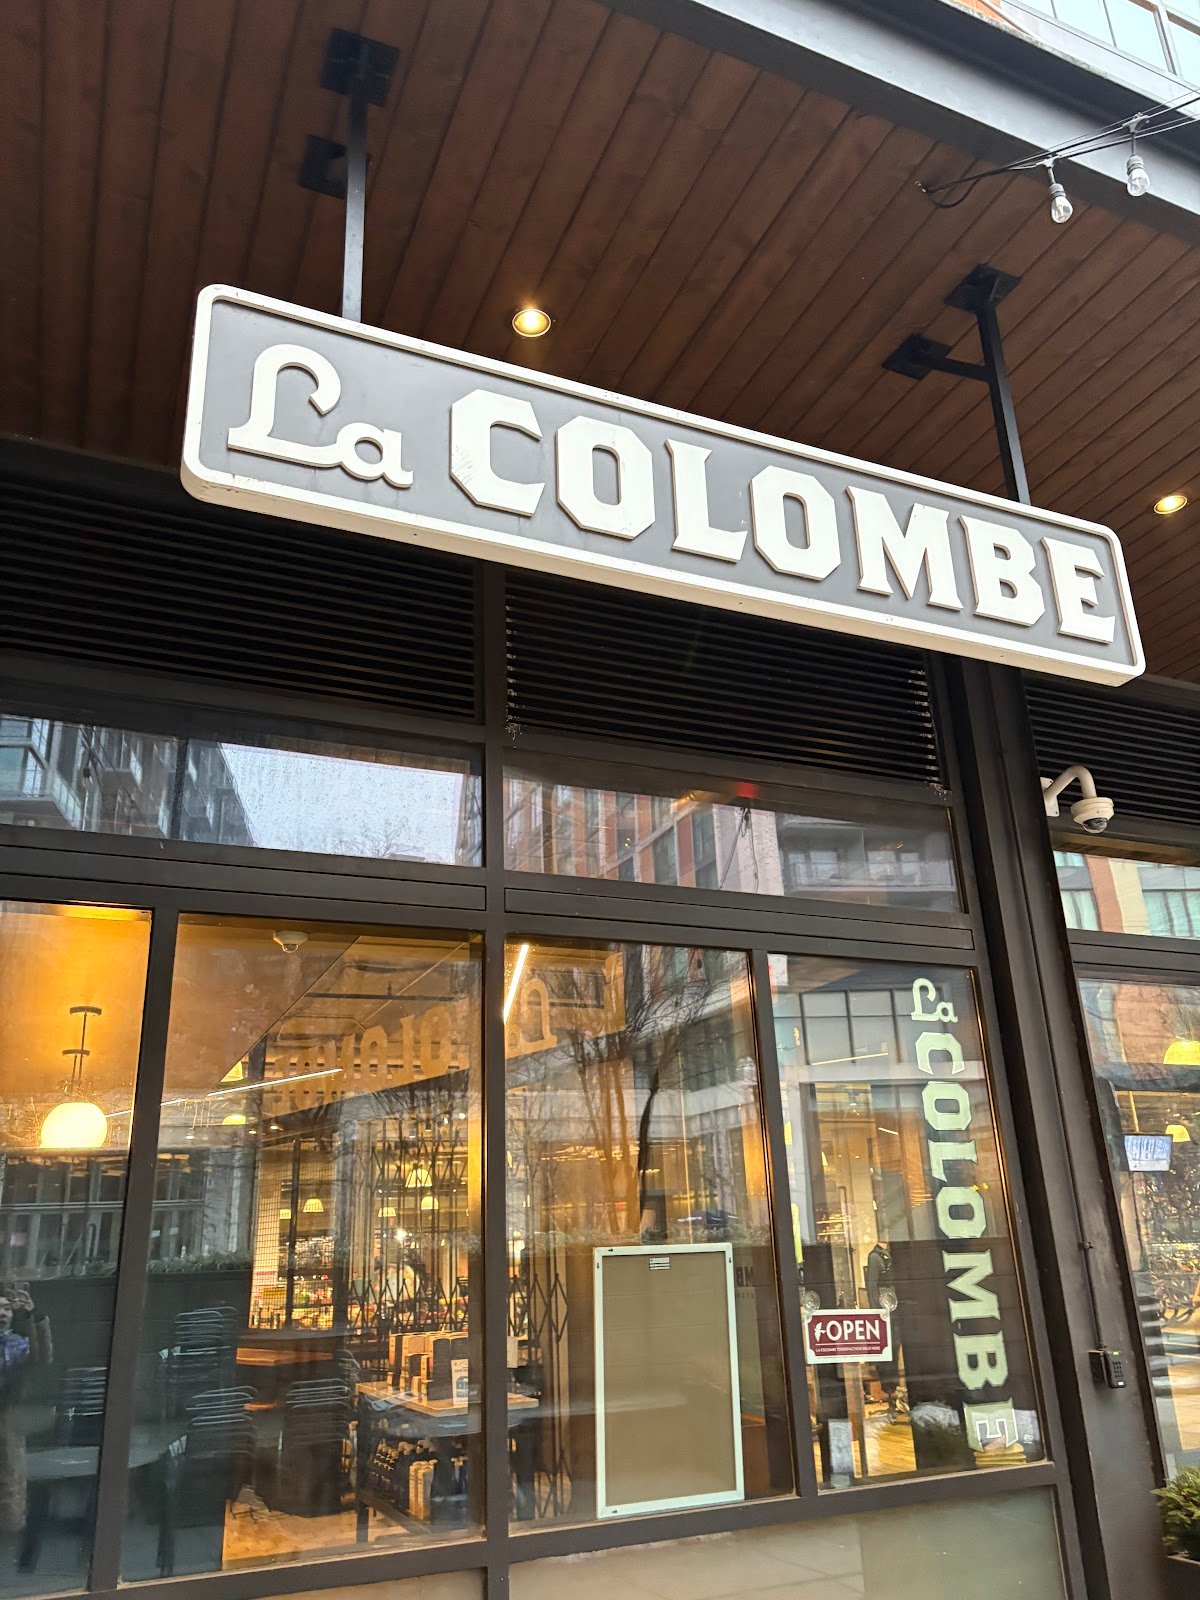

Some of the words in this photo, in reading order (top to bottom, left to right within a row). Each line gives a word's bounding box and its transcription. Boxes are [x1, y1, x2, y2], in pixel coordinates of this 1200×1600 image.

[227, 344, 414, 489] La
[450, 389, 1115, 644] COLOMBE
[911, 977, 959, 1023] La
[915, 1031, 1020, 1453] COLOMBE
[826, 1319, 880, 1341] OPEN
